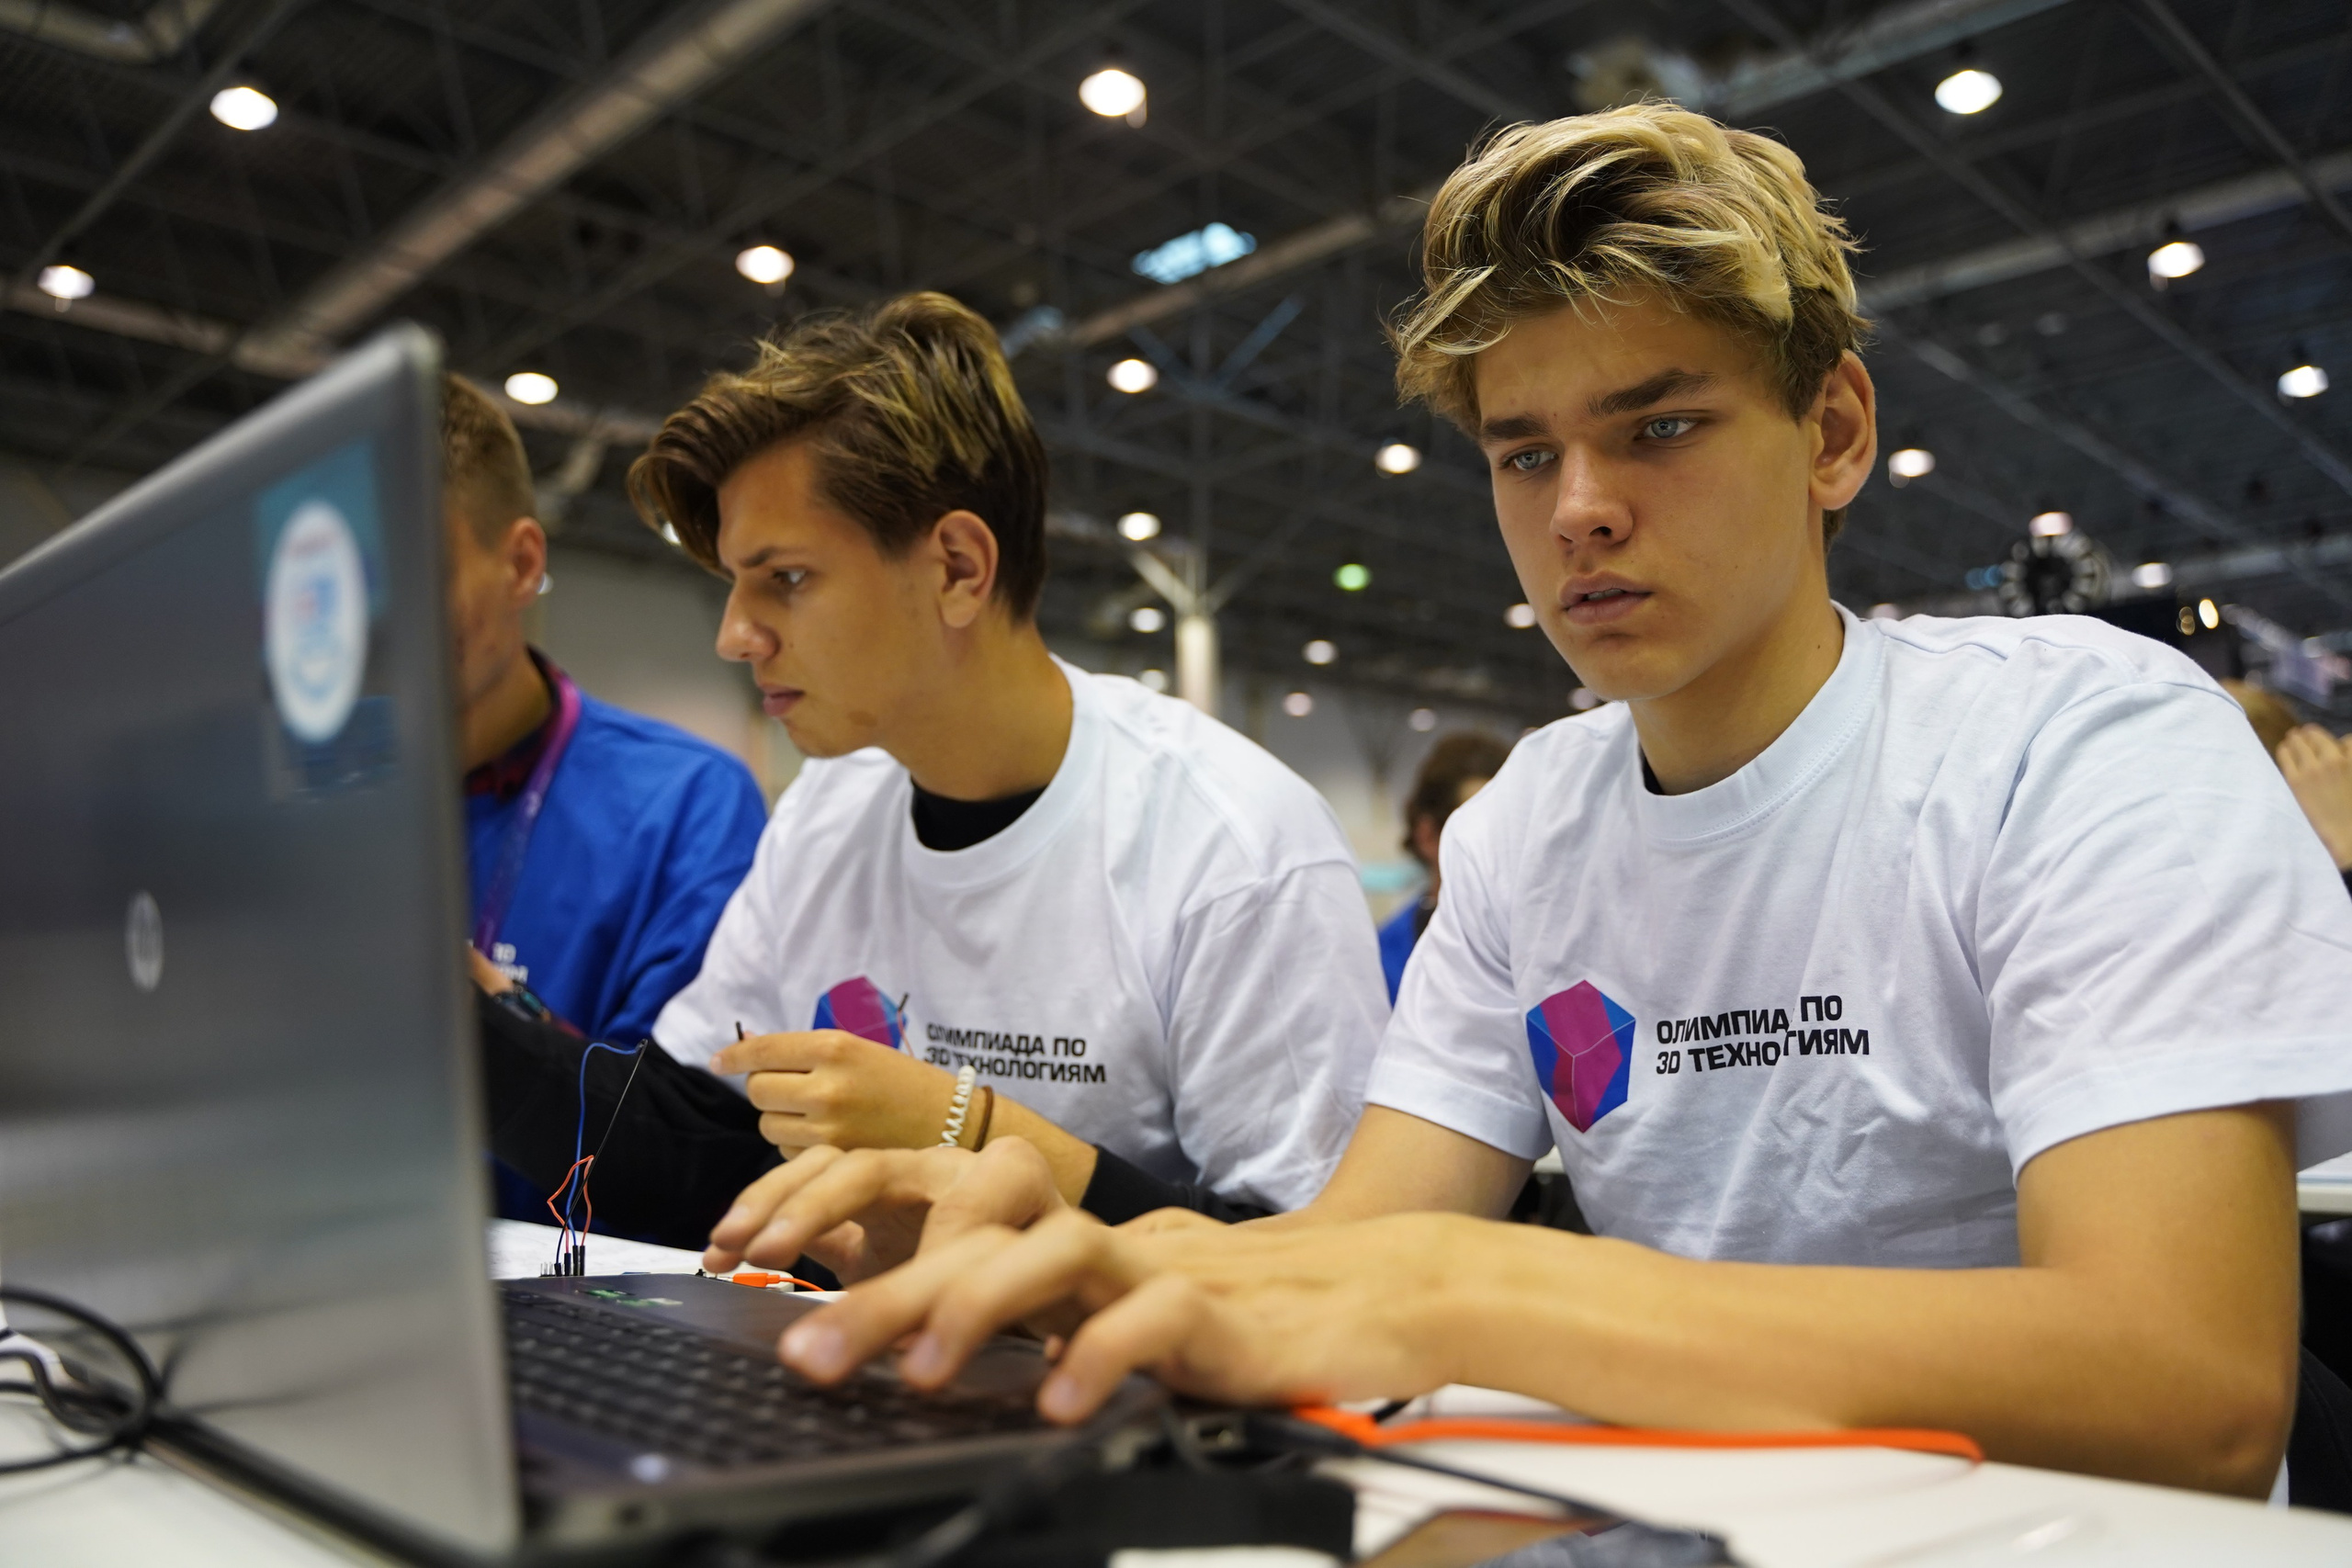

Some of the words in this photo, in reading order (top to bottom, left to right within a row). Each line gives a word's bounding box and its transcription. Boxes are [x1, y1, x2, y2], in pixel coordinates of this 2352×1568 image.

[926, 1022, 1046, 1056] ОЛИМПИАДА
[1053, 1037, 1086, 1057] ПО
[1656, 1009, 1791, 1044] ОЛИМПИА
[1800, 995, 1843, 1022] ПО
[924, 1046, 951, 1066] 3D
[1656, 1050, 1680, 1075] 3D
[1687, 1028, 1871, 1073] ТЕХНОГИЯМ
